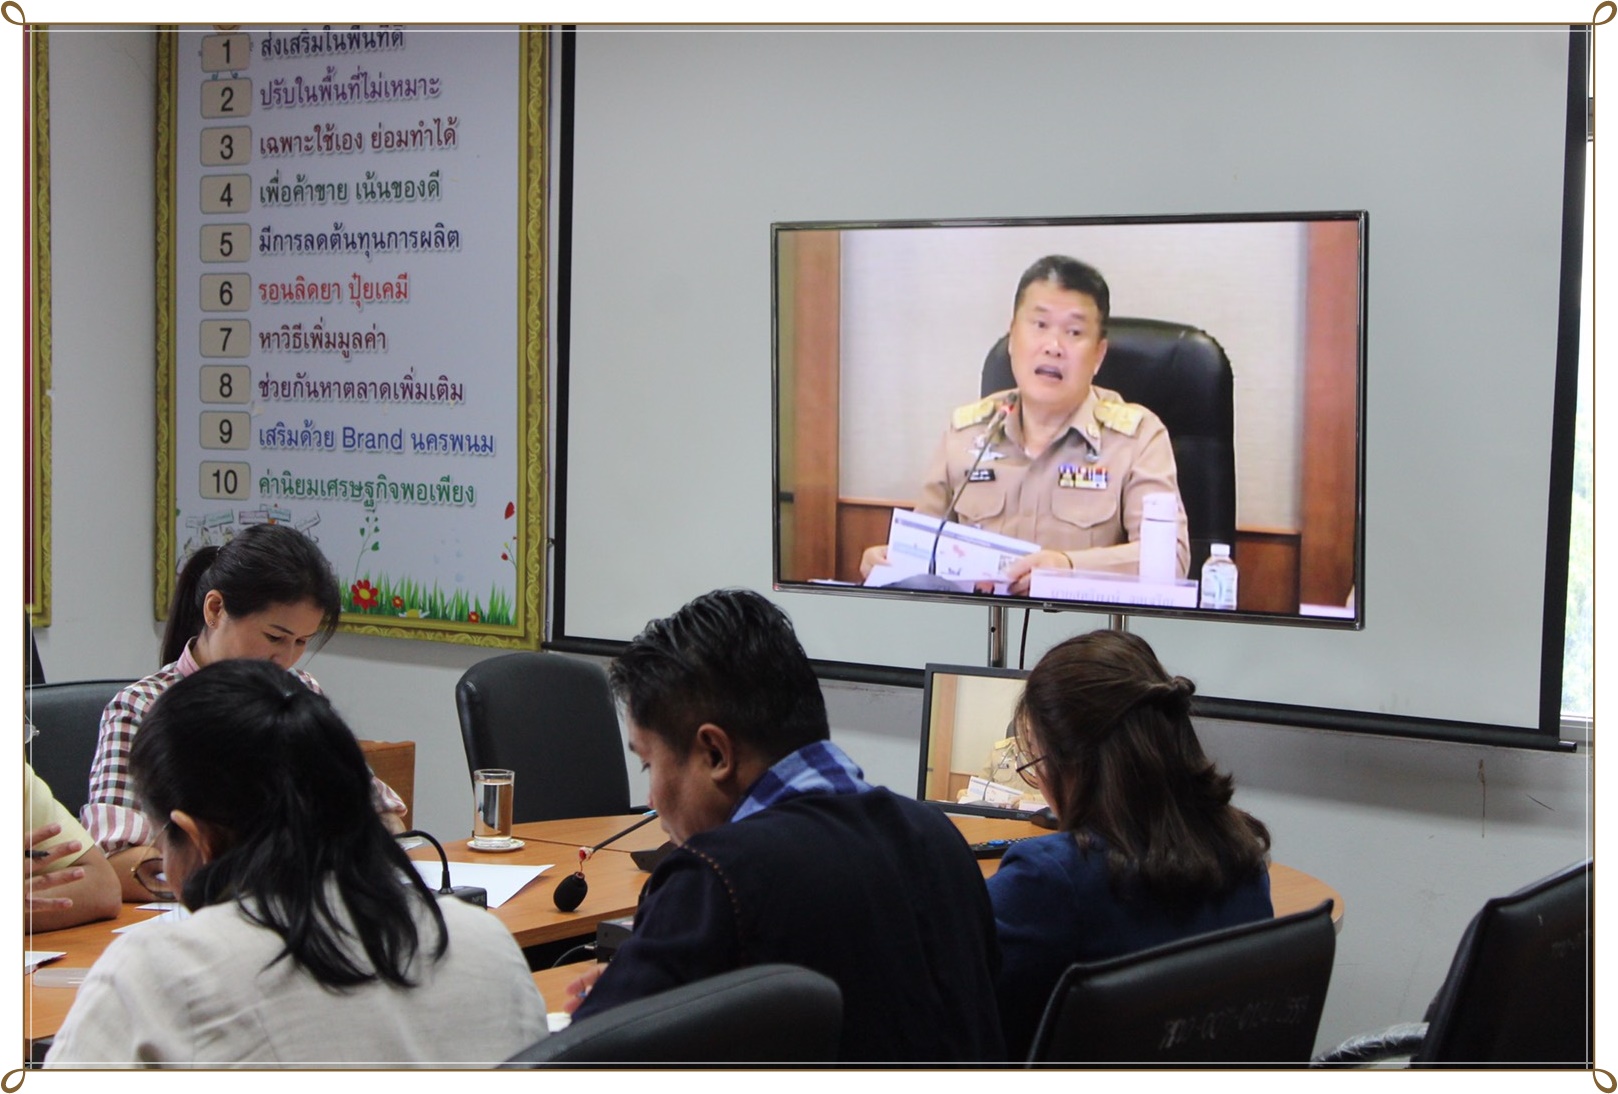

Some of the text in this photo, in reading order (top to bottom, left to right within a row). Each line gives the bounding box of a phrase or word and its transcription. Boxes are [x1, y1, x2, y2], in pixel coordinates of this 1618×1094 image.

[221, 39, 232, 64] 1
[220, 66, 440, 112] 2 ปรับในพื้นที่ไม่เหมาะ
[219, 116, 458, 160] 3 เฉพาะใช้เอง ย่อมทำได้
[219, 169, 440, 207] 4 เพื่อค้าขาย เน้นของดี
[219, 222, 460, 258] 5 มีการลดต้นทุนการผลิต
[218, 281, 233, 306] 6
[348, 272, 409, 308] ปุ๋ยเคมี
[219, 316, 387, 359] 7 หาวิธีเพิ่มมูลค่า
[218, 366, 464, 401] 8 ช่วยกันหาตลาดเพิ่มเติม
[218, 419, 495, 454] 9 เสริมด้วย Brand นครพนม
[211, 468, 475, 508] 10 ค่านิยมเศรษฐกิจพอเพียง
